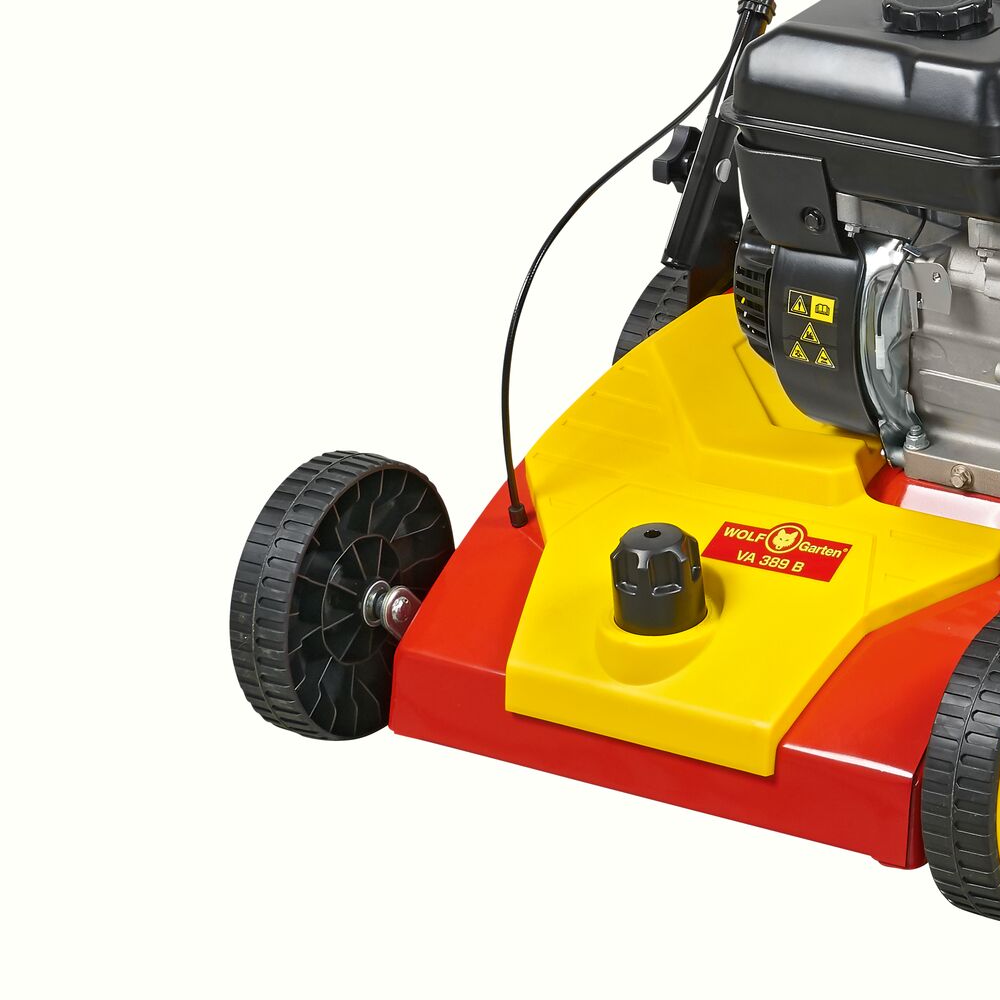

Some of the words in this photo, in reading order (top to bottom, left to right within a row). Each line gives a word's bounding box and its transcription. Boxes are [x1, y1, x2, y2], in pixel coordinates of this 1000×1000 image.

[724, 527, 767, 542] WOLF
[737, 550, 756, 563] VA
[759, 556, 790, 569] 389
[792, 561, 805, 573] B
